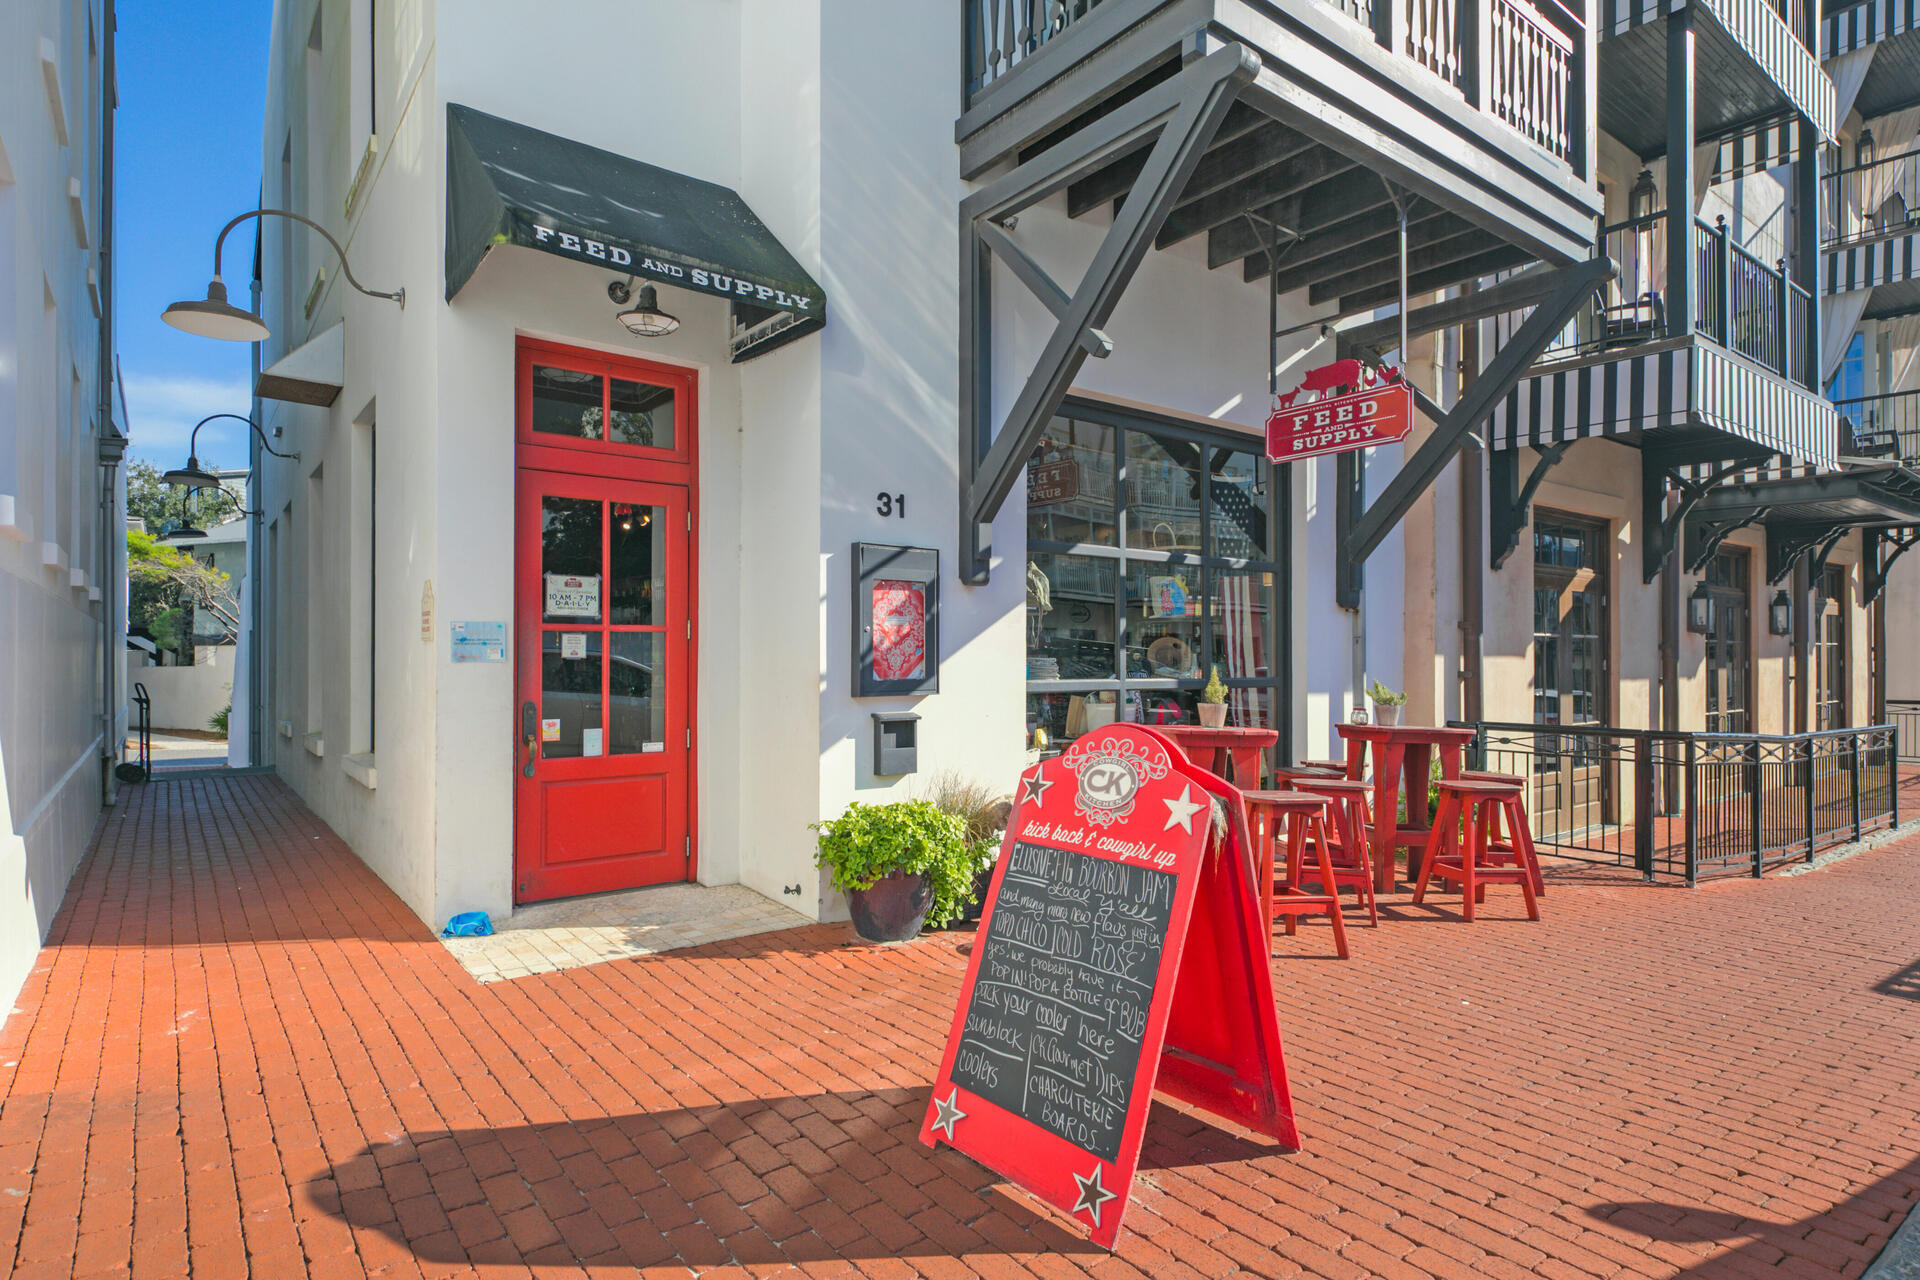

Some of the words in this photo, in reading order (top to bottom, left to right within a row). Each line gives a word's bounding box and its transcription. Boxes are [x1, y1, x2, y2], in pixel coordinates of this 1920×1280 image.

[533, 224, 631, 266] FEED
[641, 258, 684, 278] AND
[691, 268, 811, 310] SUPPLY
[1293, 400, 1378, 431] FEED
[1323, 424, 1344, 433] AND
[1293, 424, 1377, 451] SUPPLY
[877, 491, 905, 519] 31
[585, 594, 597, 602] PM
[1086, 769, 1127, 796] CK
[1092, 758, 1130, 773] COWGIRL
[1084, 793, 1123, 806] KITCHEN
[1022, 819, 1051, 839] kick
[1051, 823, 1085, 845] back
[1084, 830, 1098, 848] &
[1097, 836, 1157, 861] cowgirl
[1153, 850, 1177, 870] up
[1047, 881, 1091, 902] Local
[1078, 856, 1130, 897] BOURBON
[1134, 870, 1170, 911] JAM
[994, 909, 1016, 937] TOPO
[1015, 916, 1048, 947] CHICO
[1000, 887, 1020, 903] and
[1020, 896, 1046, 921] many
[1070, 906, 1092, 923] new
[1148, 928, 1161, 946] in
[1056, 925, 1082, 958] COLD
[1011, 948, 1026, 963] we
[1030, 956, 1074, 986] probably
[1078, 967, 1105, 990] have
[1111, 980, 1124, 994] it
[973, 982, 1001, 1007] pack
[1003, 991, 1034, 1015] your
[1035, 1002, 1072, 1032] cooler
[1078, 1015, 1115, 1055] here
[991, 960, 1011, 980] POP
[1028, 972, 1051, 993] POP
[1050, 980, 1061, 995] A
[1063, 983, 1104, 1006] BOTTLE
[1103, 998, 1120, 1032] of
[1119, 1001, 1146, 1038] BUB
[963, 1012, 1026, 1053] sunblock
[958, 1048, 999, 1089] coolers
[1032, 1034, 1047, 1061] CK
[1095, 1056, 1125, 1104] DIPS
[1041, 1100, 1099, 1150] BOARDS
